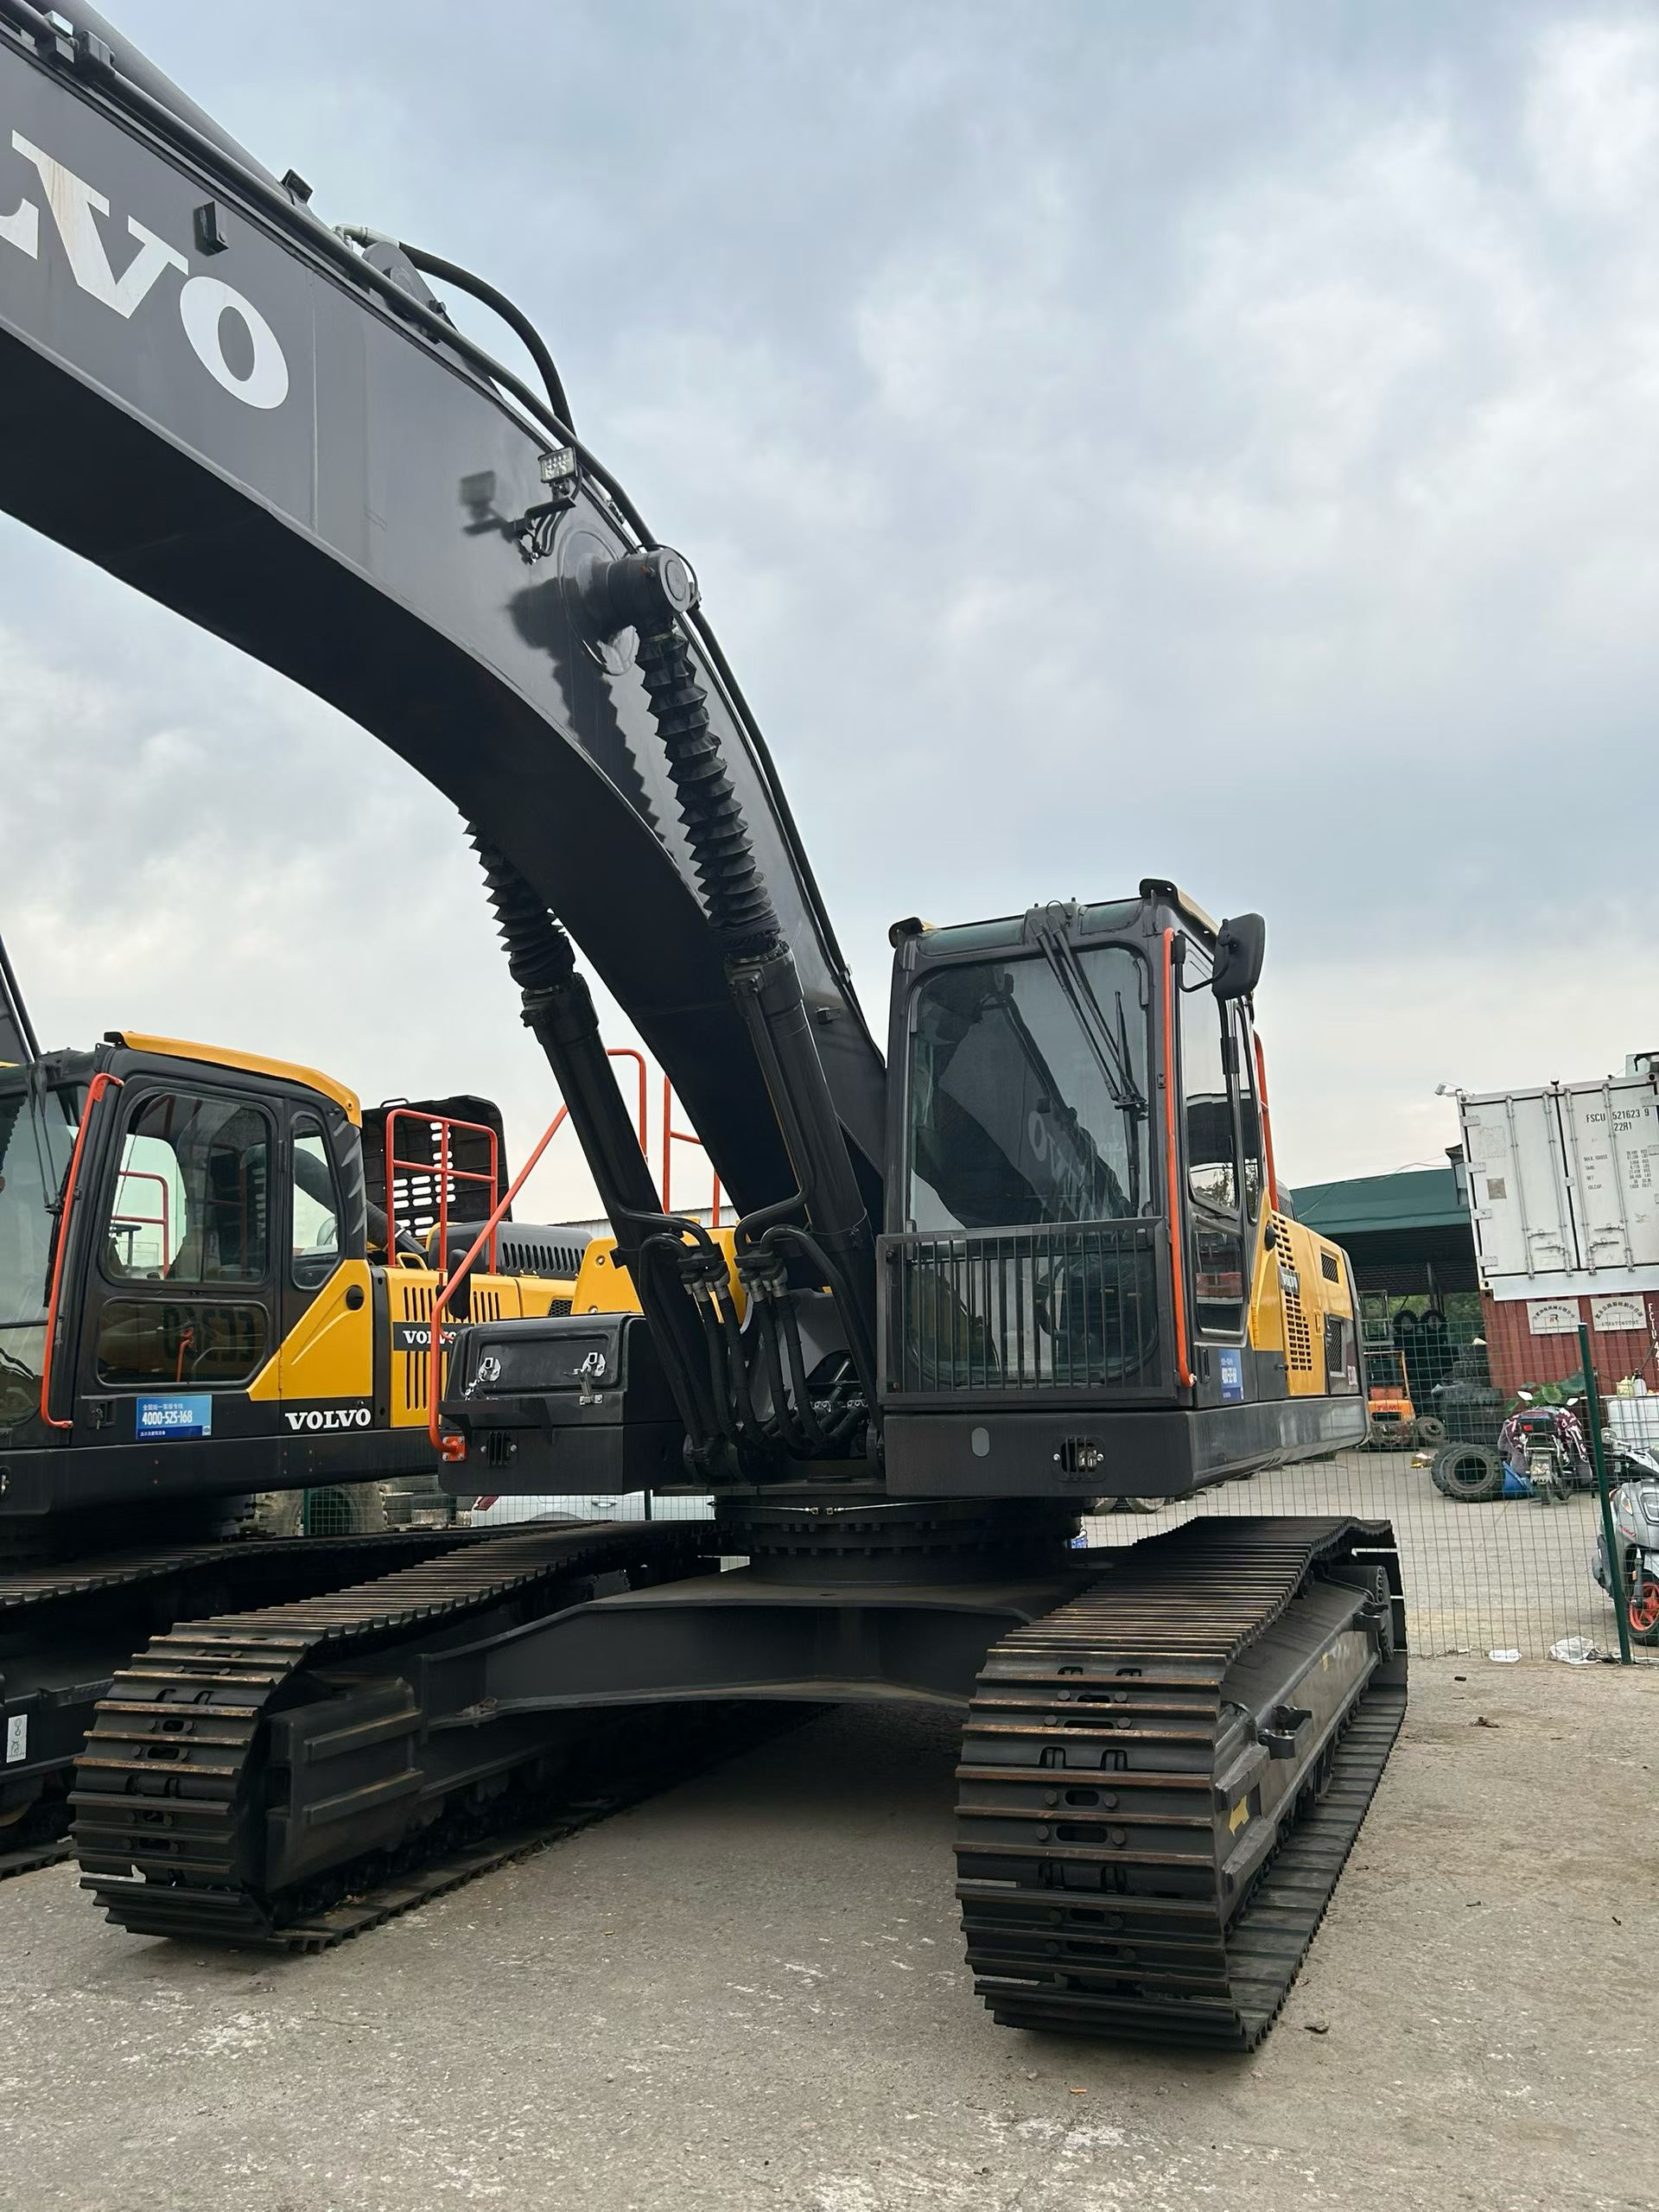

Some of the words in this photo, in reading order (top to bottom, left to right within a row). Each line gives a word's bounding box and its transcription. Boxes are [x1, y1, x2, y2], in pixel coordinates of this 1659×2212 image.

[1586, 1112, 1605, 1122] FSCU
[1611, 1109, 1640, 1120] 521623
[1643, 1108, 1649, 1116] 9
[1614, 1122, 1632, 1131] 22R1
[142, 1409, 194, 1426] 4000-525-168
[284, 1408, 372, 1431] VOLVO
